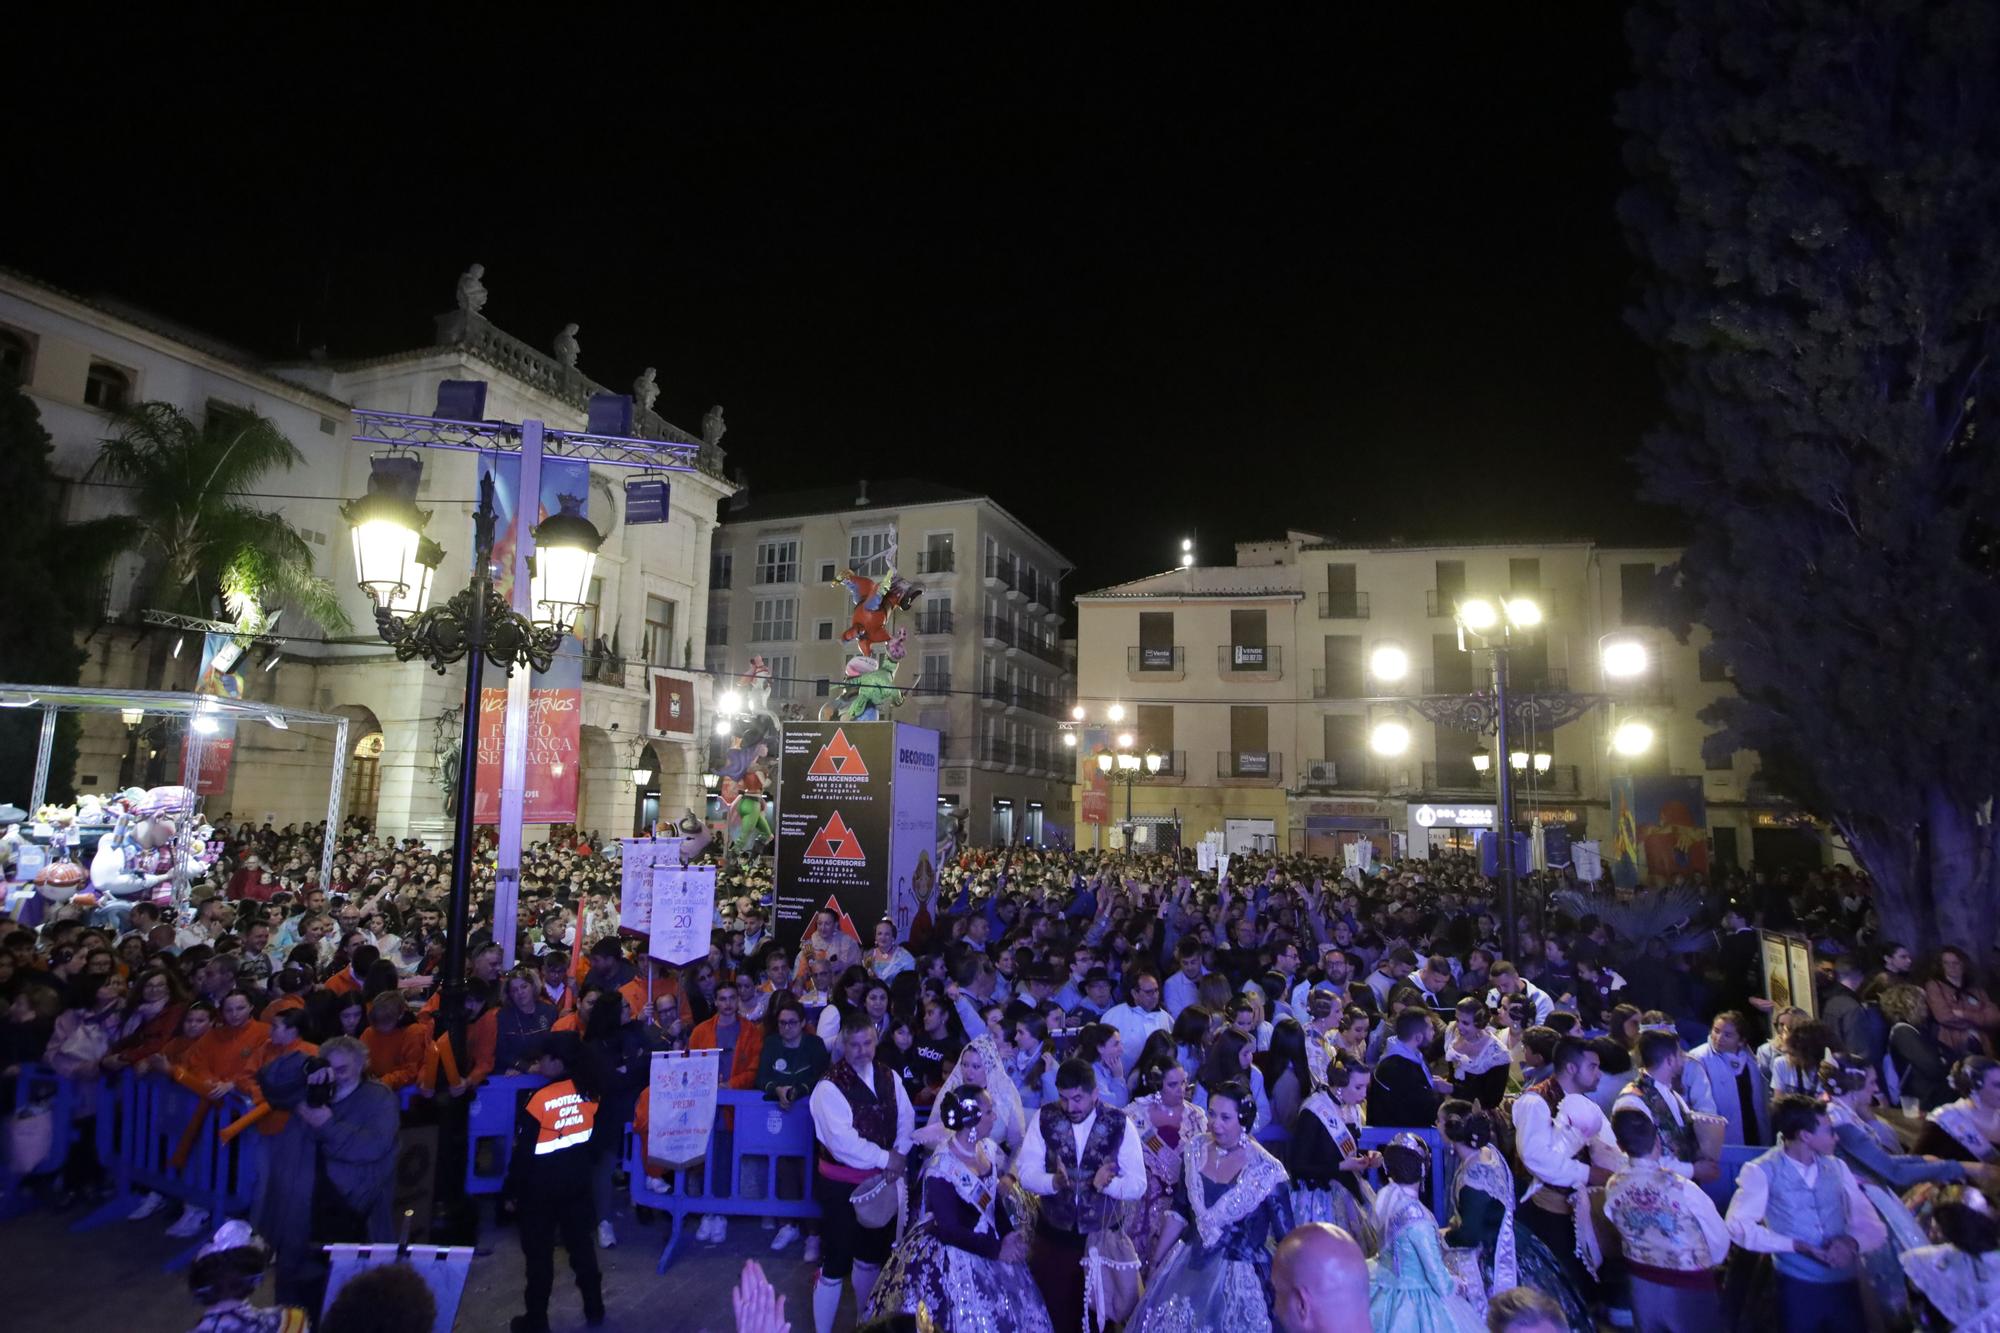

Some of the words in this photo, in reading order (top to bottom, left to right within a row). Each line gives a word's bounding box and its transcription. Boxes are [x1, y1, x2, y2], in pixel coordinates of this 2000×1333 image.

[478, 738, 505, 751] UE
[526, 738, 573, 751] UNCA
[900, 748, 936, 768] DECOFRED
[824, 859, 866, 867] ASCENSORES
[674, 915, 692, 928] 20
[672, 1099, 696, 1109] PREMI
[559, 1104, 580, 1118] CIVIL
[679, 1111, 688, 1126] 4
